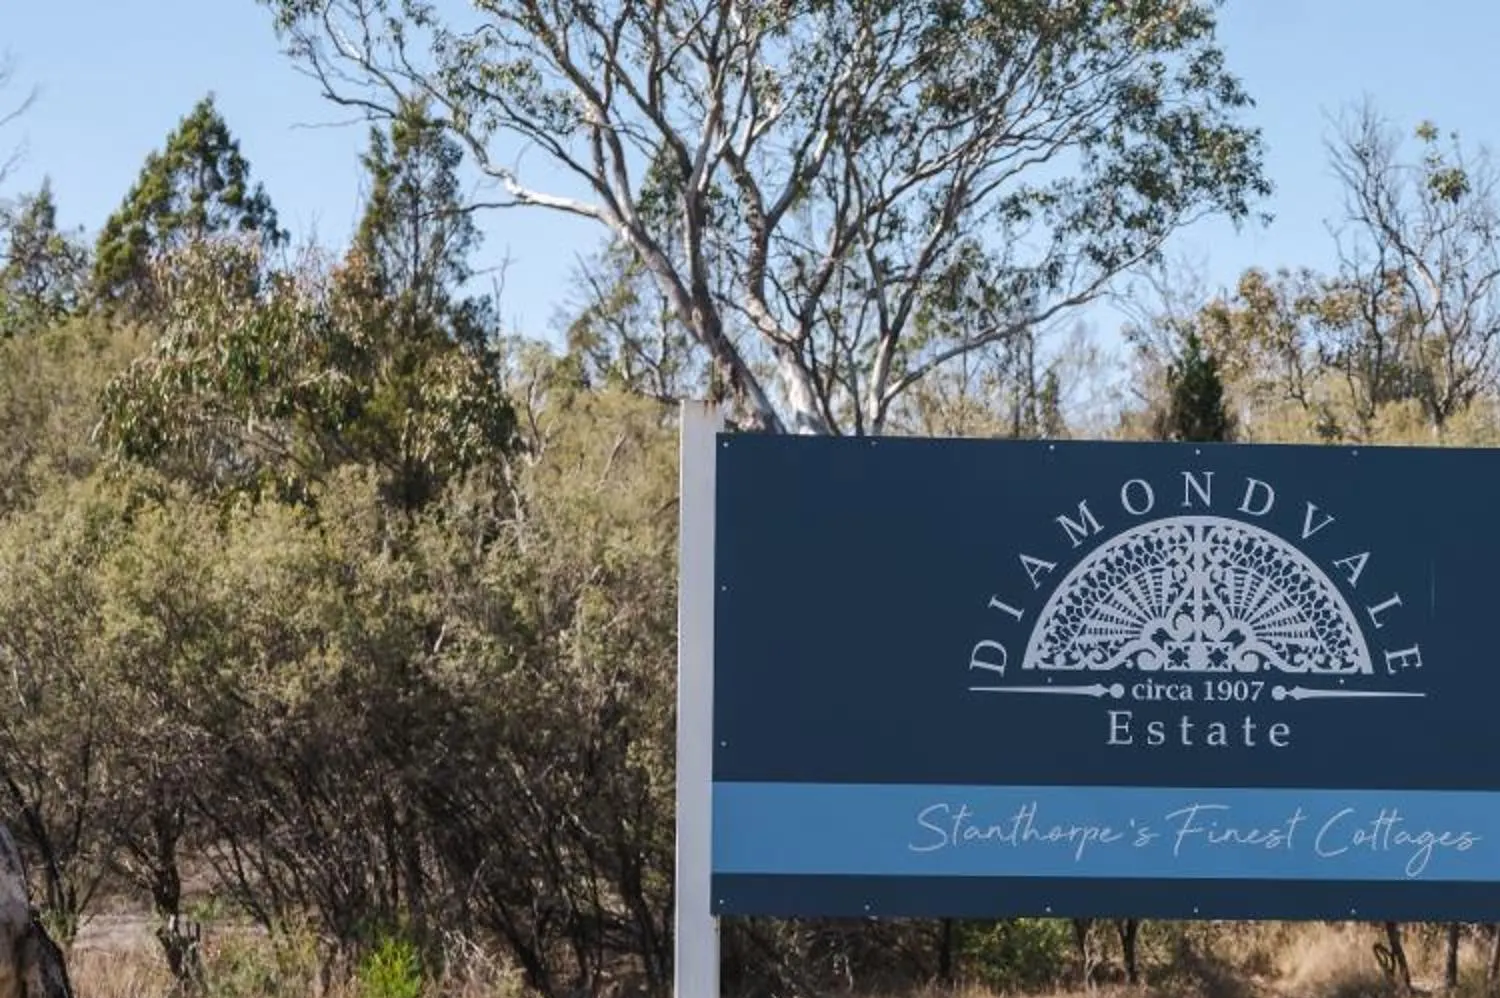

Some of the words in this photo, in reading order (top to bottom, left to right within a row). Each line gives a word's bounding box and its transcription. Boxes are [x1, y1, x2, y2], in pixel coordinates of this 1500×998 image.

[969, 470, 1424, 677] DIAMONDVALE
[1131, 679, 1194, 702] circa
[1204, 680, 1265, 702] 1907
[1106, 710, 1292, 747] Estate
[908, 801, 1159, 862] Stanthorpe's
[1165, 804, 1309, 857] Finest
[1315, 806, 1482, 878] Cottages
